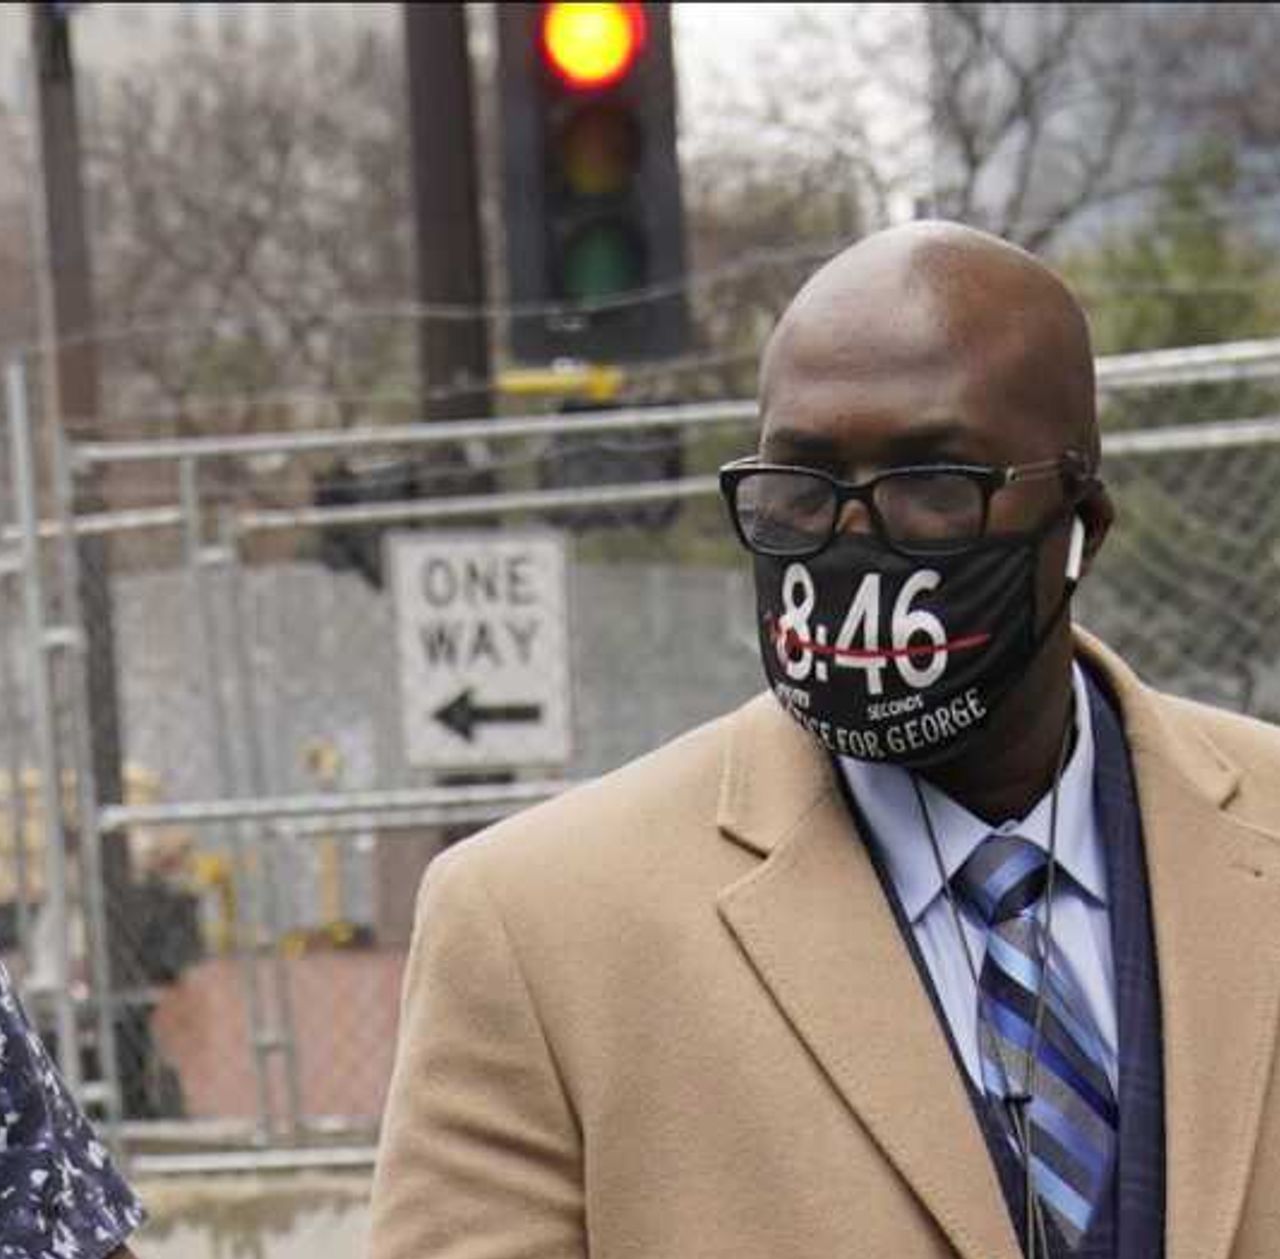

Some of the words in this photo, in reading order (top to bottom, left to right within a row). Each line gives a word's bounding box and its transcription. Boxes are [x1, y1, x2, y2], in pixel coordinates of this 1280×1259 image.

[423, 556, 540, 607] ONE
[422, 619, 541, 666] WAY
[775, 562, 948, 695] 8:46
[836, 727, 886, 758] FOR
[886, 688, 988, 753] GEORGE
